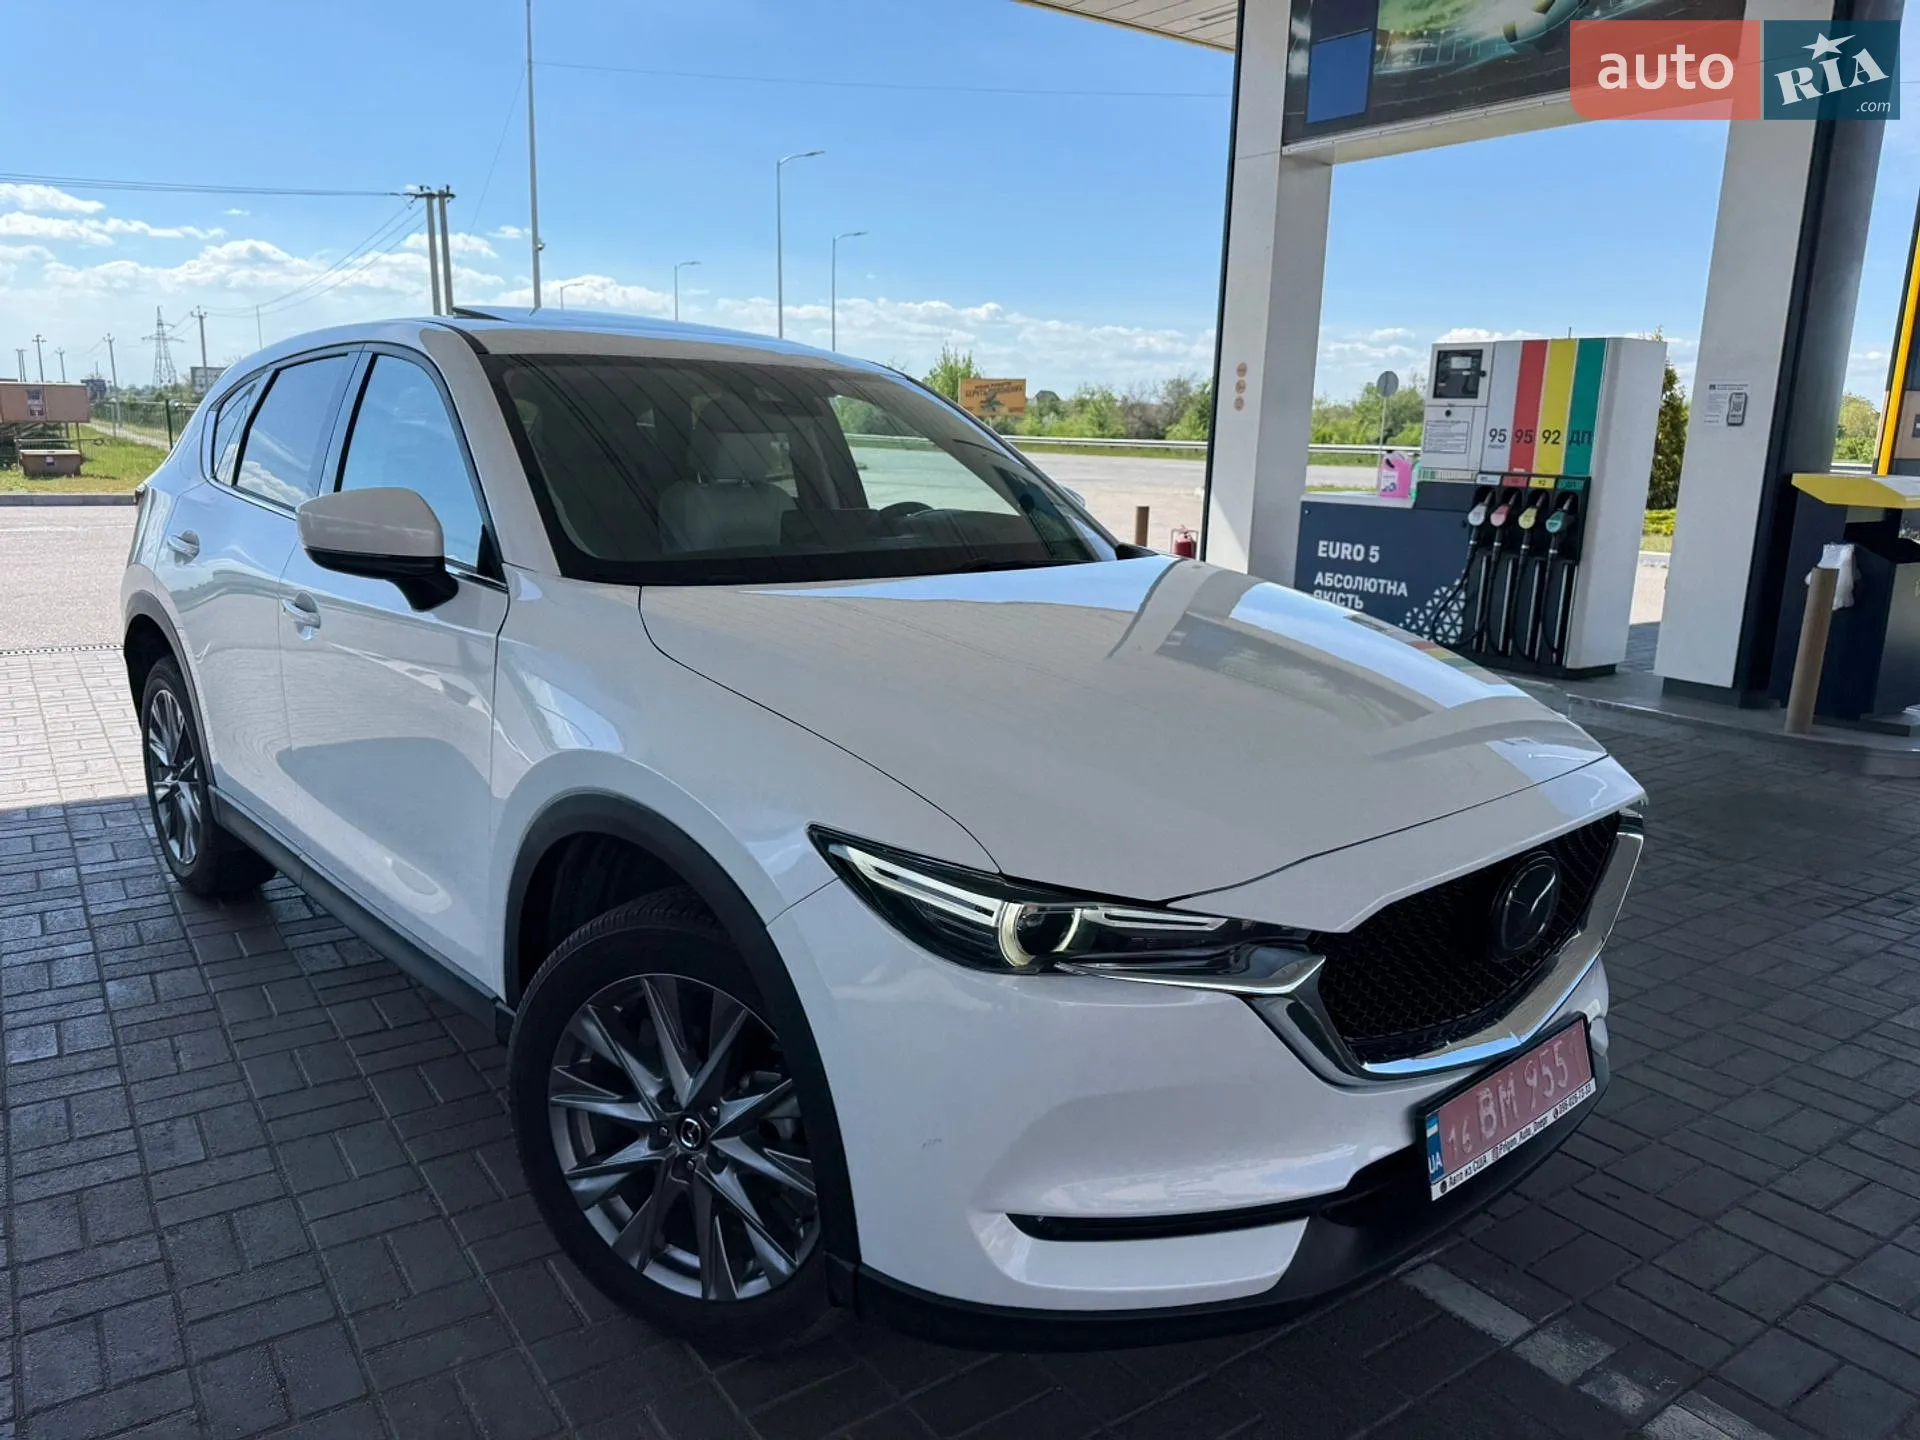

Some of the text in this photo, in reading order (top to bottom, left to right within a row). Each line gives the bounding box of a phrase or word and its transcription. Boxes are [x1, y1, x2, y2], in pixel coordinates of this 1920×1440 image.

[1489, 428, 1507, 444] 95
[1515, 429, 1534, 444] 95
[1542, 430, 1561, 445] 92
[1568, 430, 1595, 447] ДП
[1318, 540, 1380, 564] EURO 5
[1314, 571, 1408, 598] АБСОЛЮТНА
[1428, 1151, 1443, 1175] UA
